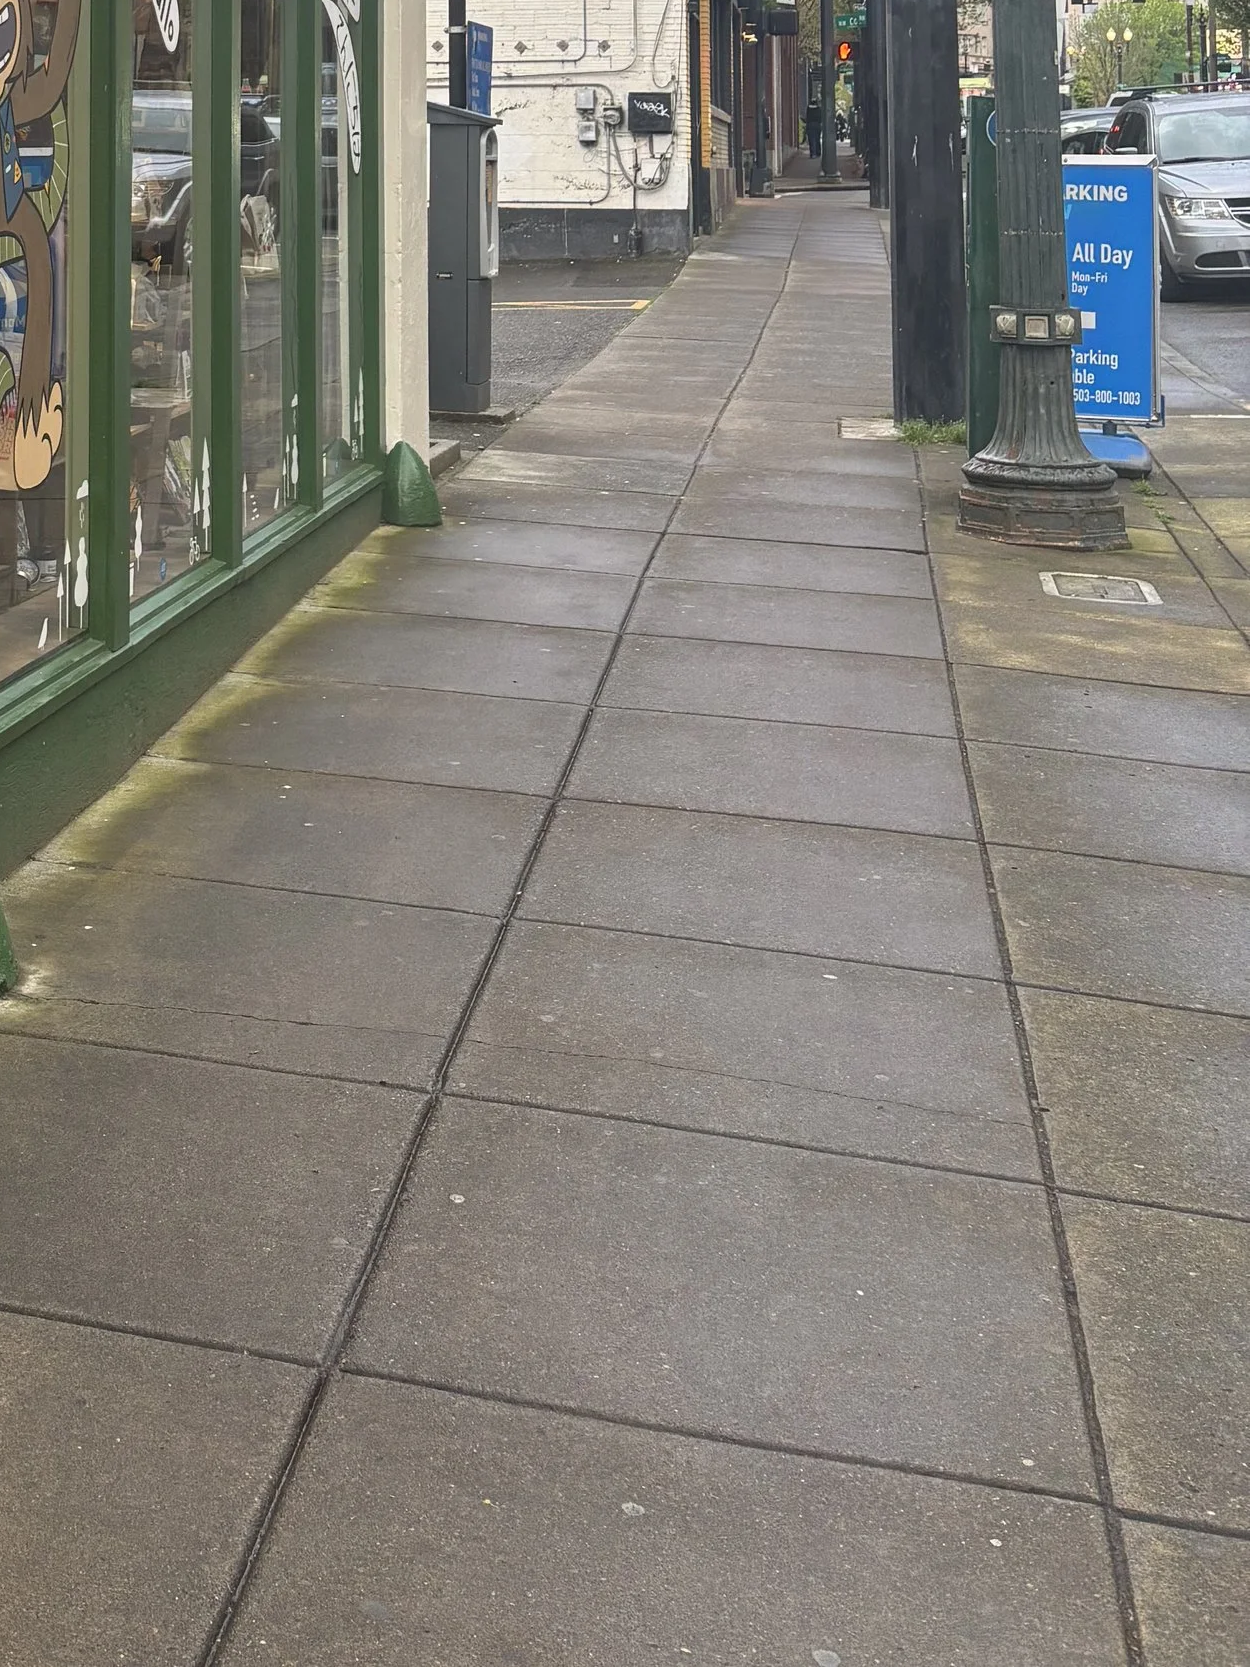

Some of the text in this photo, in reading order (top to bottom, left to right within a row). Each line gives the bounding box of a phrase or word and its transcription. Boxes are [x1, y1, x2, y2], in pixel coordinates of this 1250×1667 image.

[1063, 184, 1128, 202] RKING
[1072, 242, 1133, 269] All Day
[1071, 271, 1108, 283] Mon-Fri
[1071, 283, 1088, 296] Day
[1073, 388, 1141, 405] 503-800-1003
